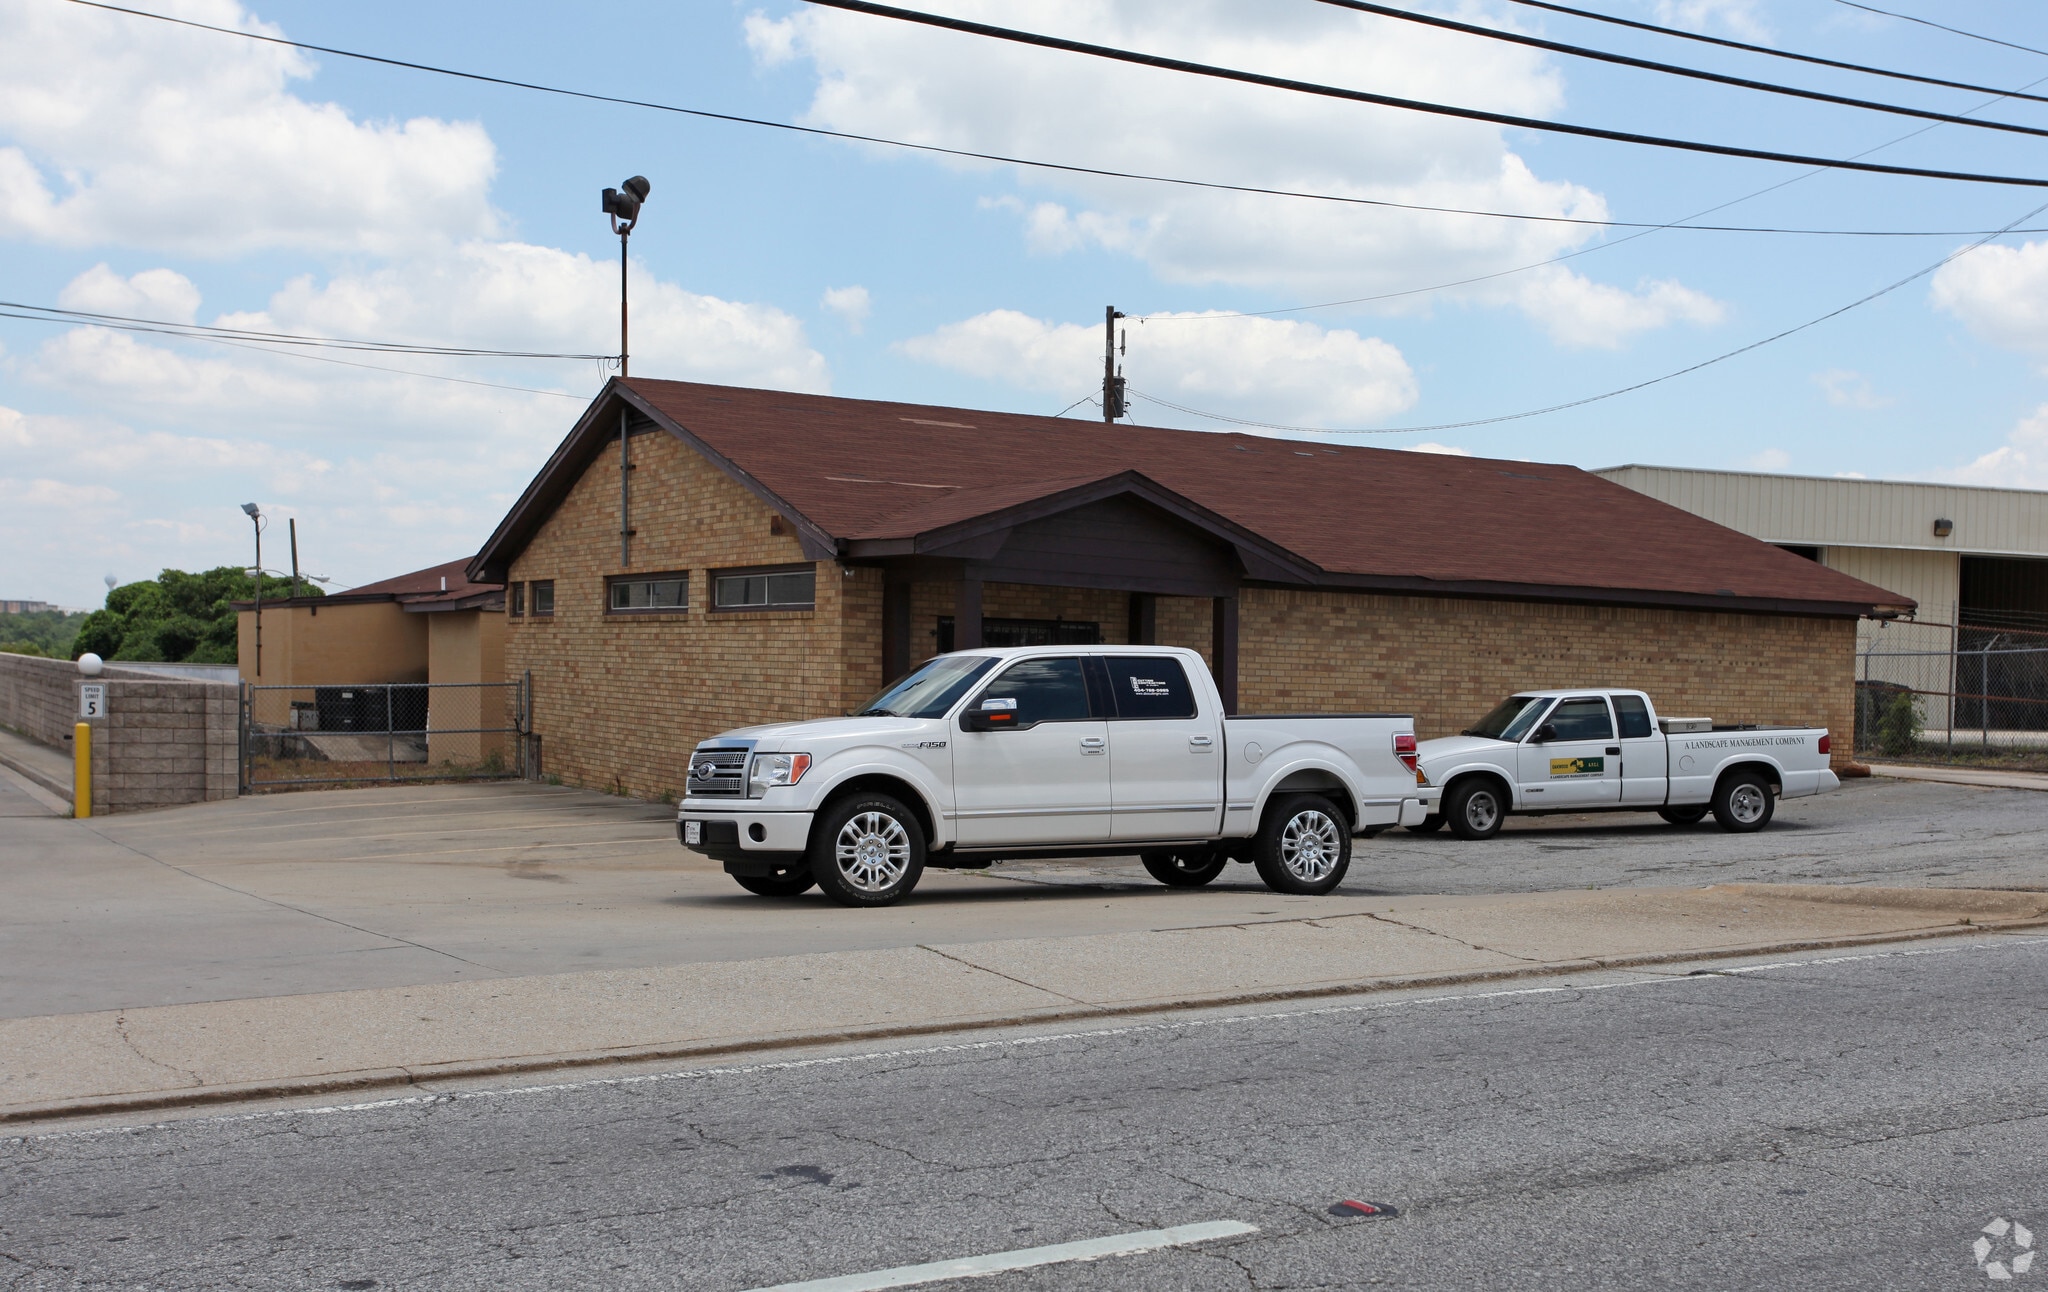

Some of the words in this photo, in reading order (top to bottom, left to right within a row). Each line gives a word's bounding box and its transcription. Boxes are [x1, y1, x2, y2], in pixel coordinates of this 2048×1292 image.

[88, 702, 96, 715] 5
[1691, 740, 1729, 749] LANDSCAPE
[1730, 738, 1774, 748] MANAGEMENT
[1775, 737, 1806, 746] COMPANY
[856, 801, 896, 811] PIRELLI
